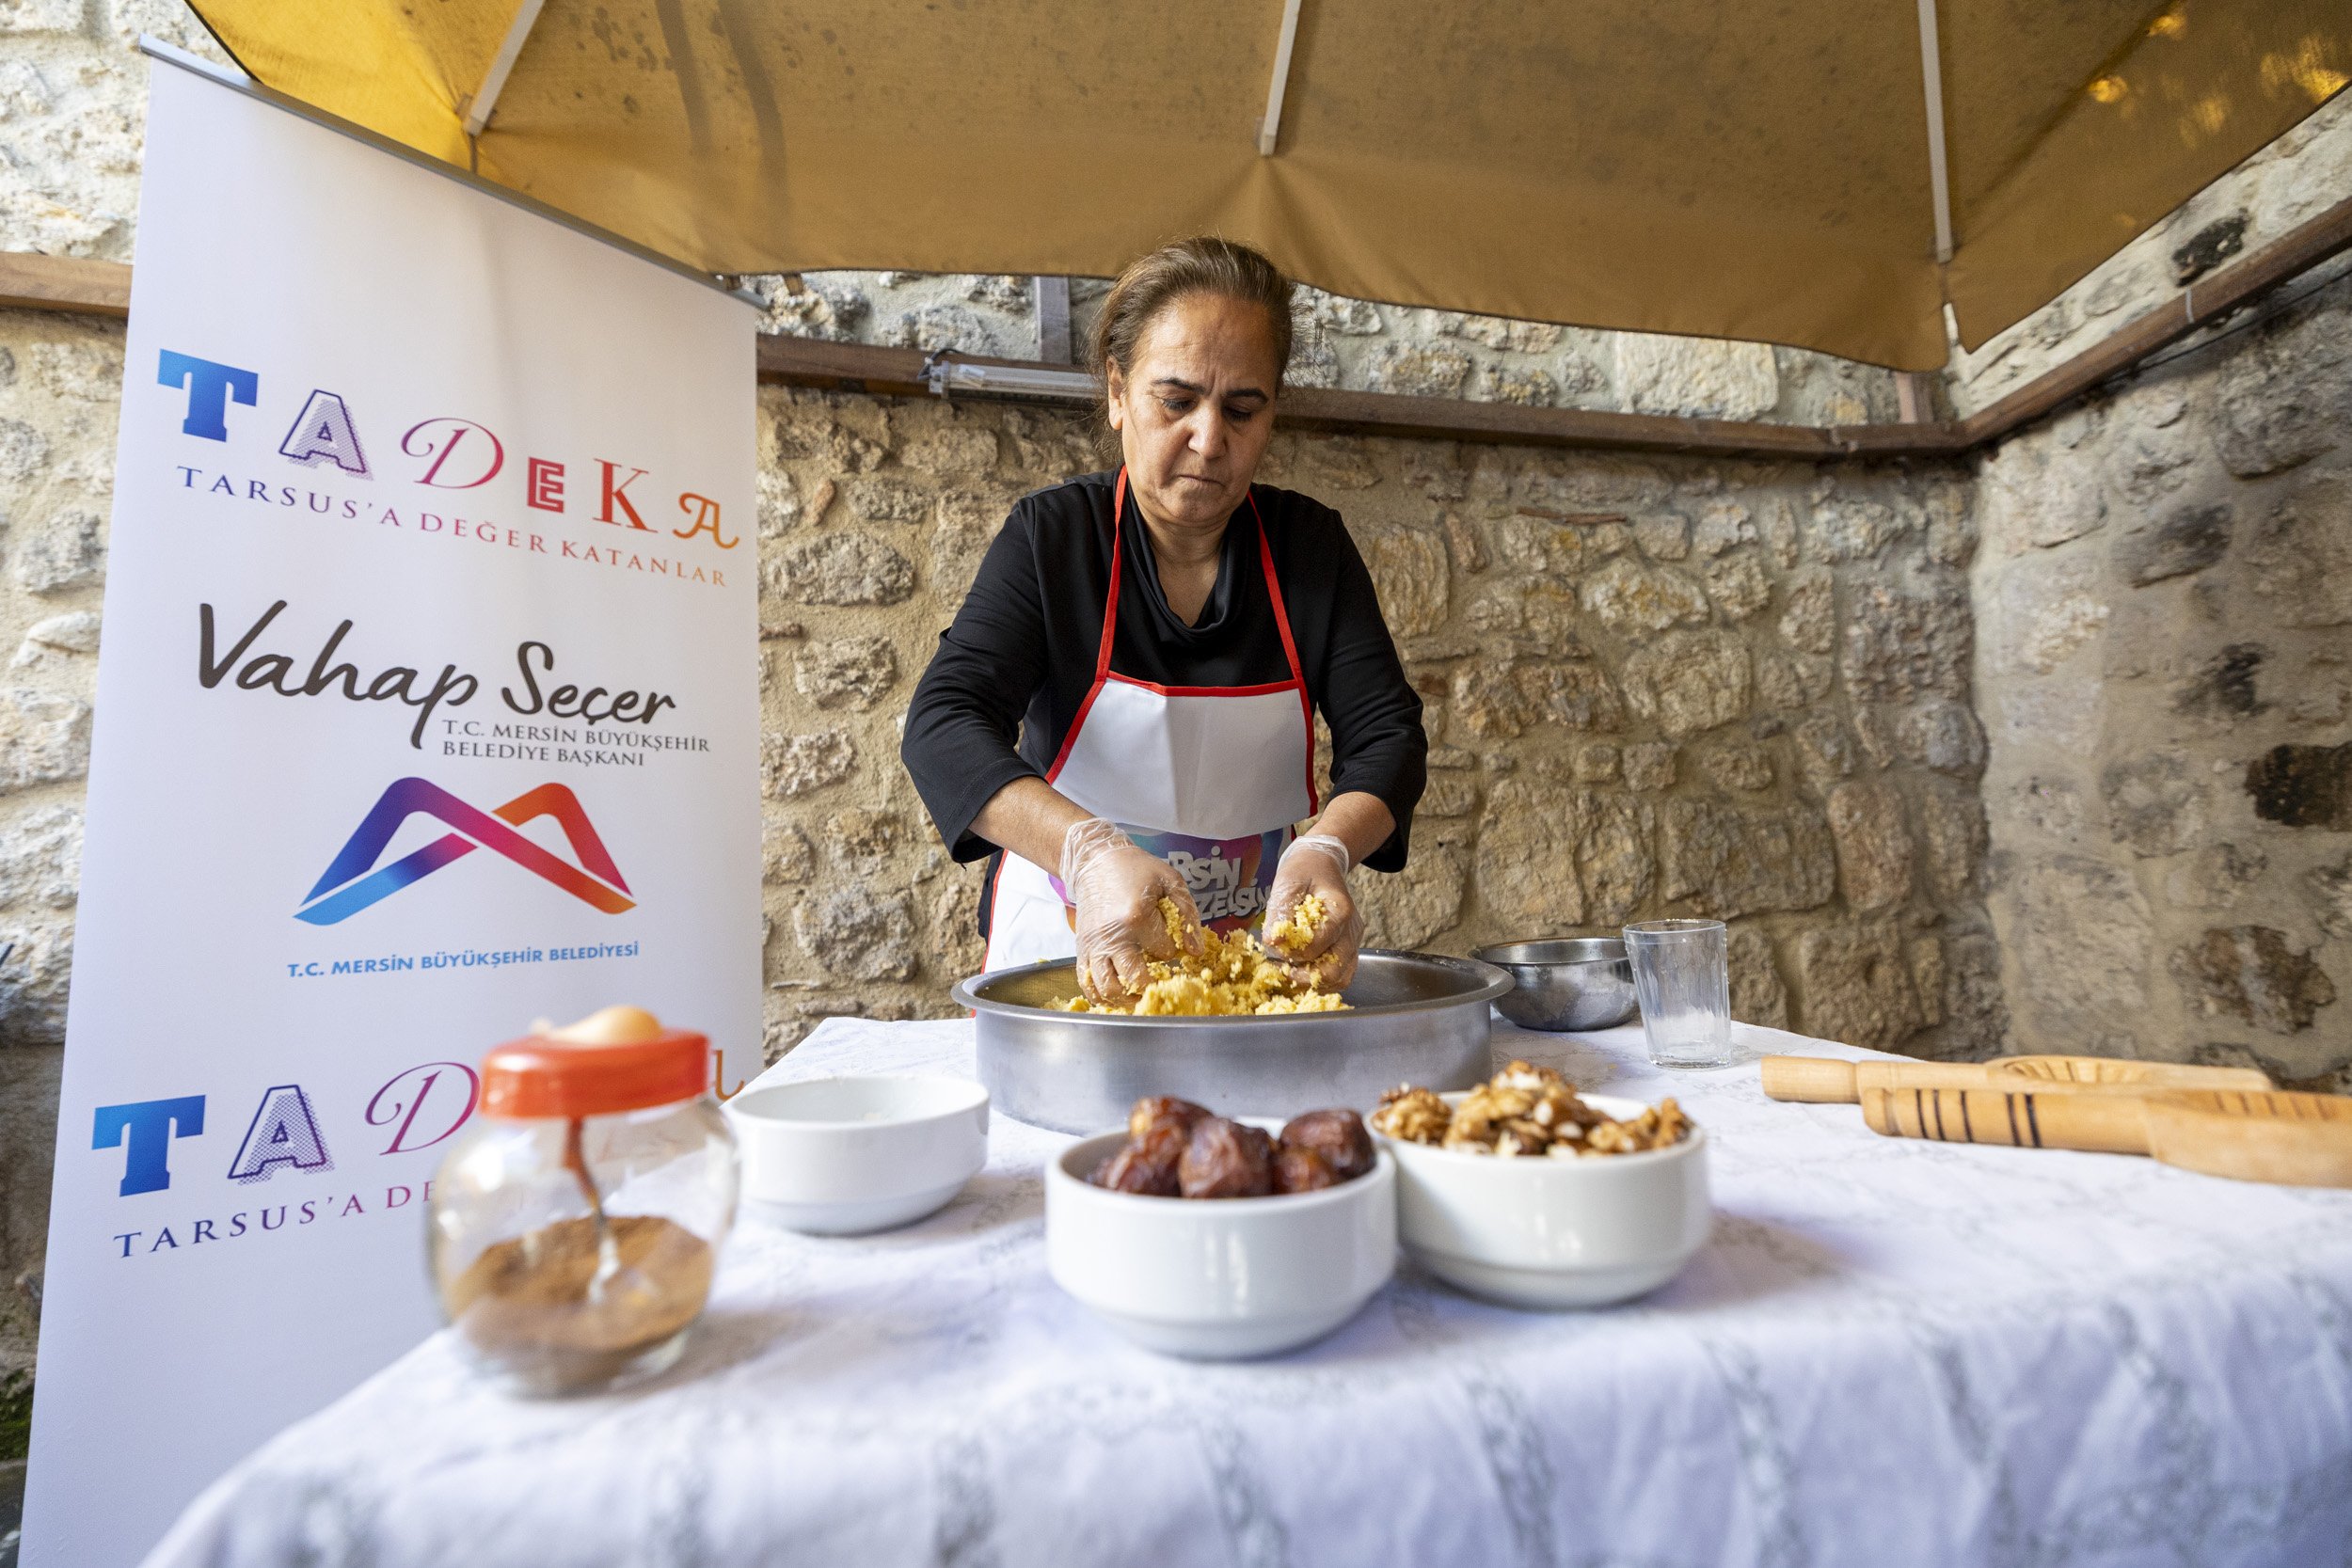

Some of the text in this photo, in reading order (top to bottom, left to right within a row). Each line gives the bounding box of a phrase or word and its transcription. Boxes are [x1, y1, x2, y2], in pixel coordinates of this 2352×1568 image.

[158, 348, 739, 549] TADEKA
[420, 513, 548, 553] DEĞER
[561, 541, 726, 587] KATANLAR
[199, 600, 676, 750] Vahap Seçer
[442, 720, 710, 752] T.C. MERSİN BÜYÜKŞEHİR
[443, 741, 644, 767] BELEDİYE BAŞKANI
[1162, 846, 1241, 891] RSİN
[288, 941, 639, 977] T.C. MERSİN BÜYÜKŞEHİR BELEDİYESİ
